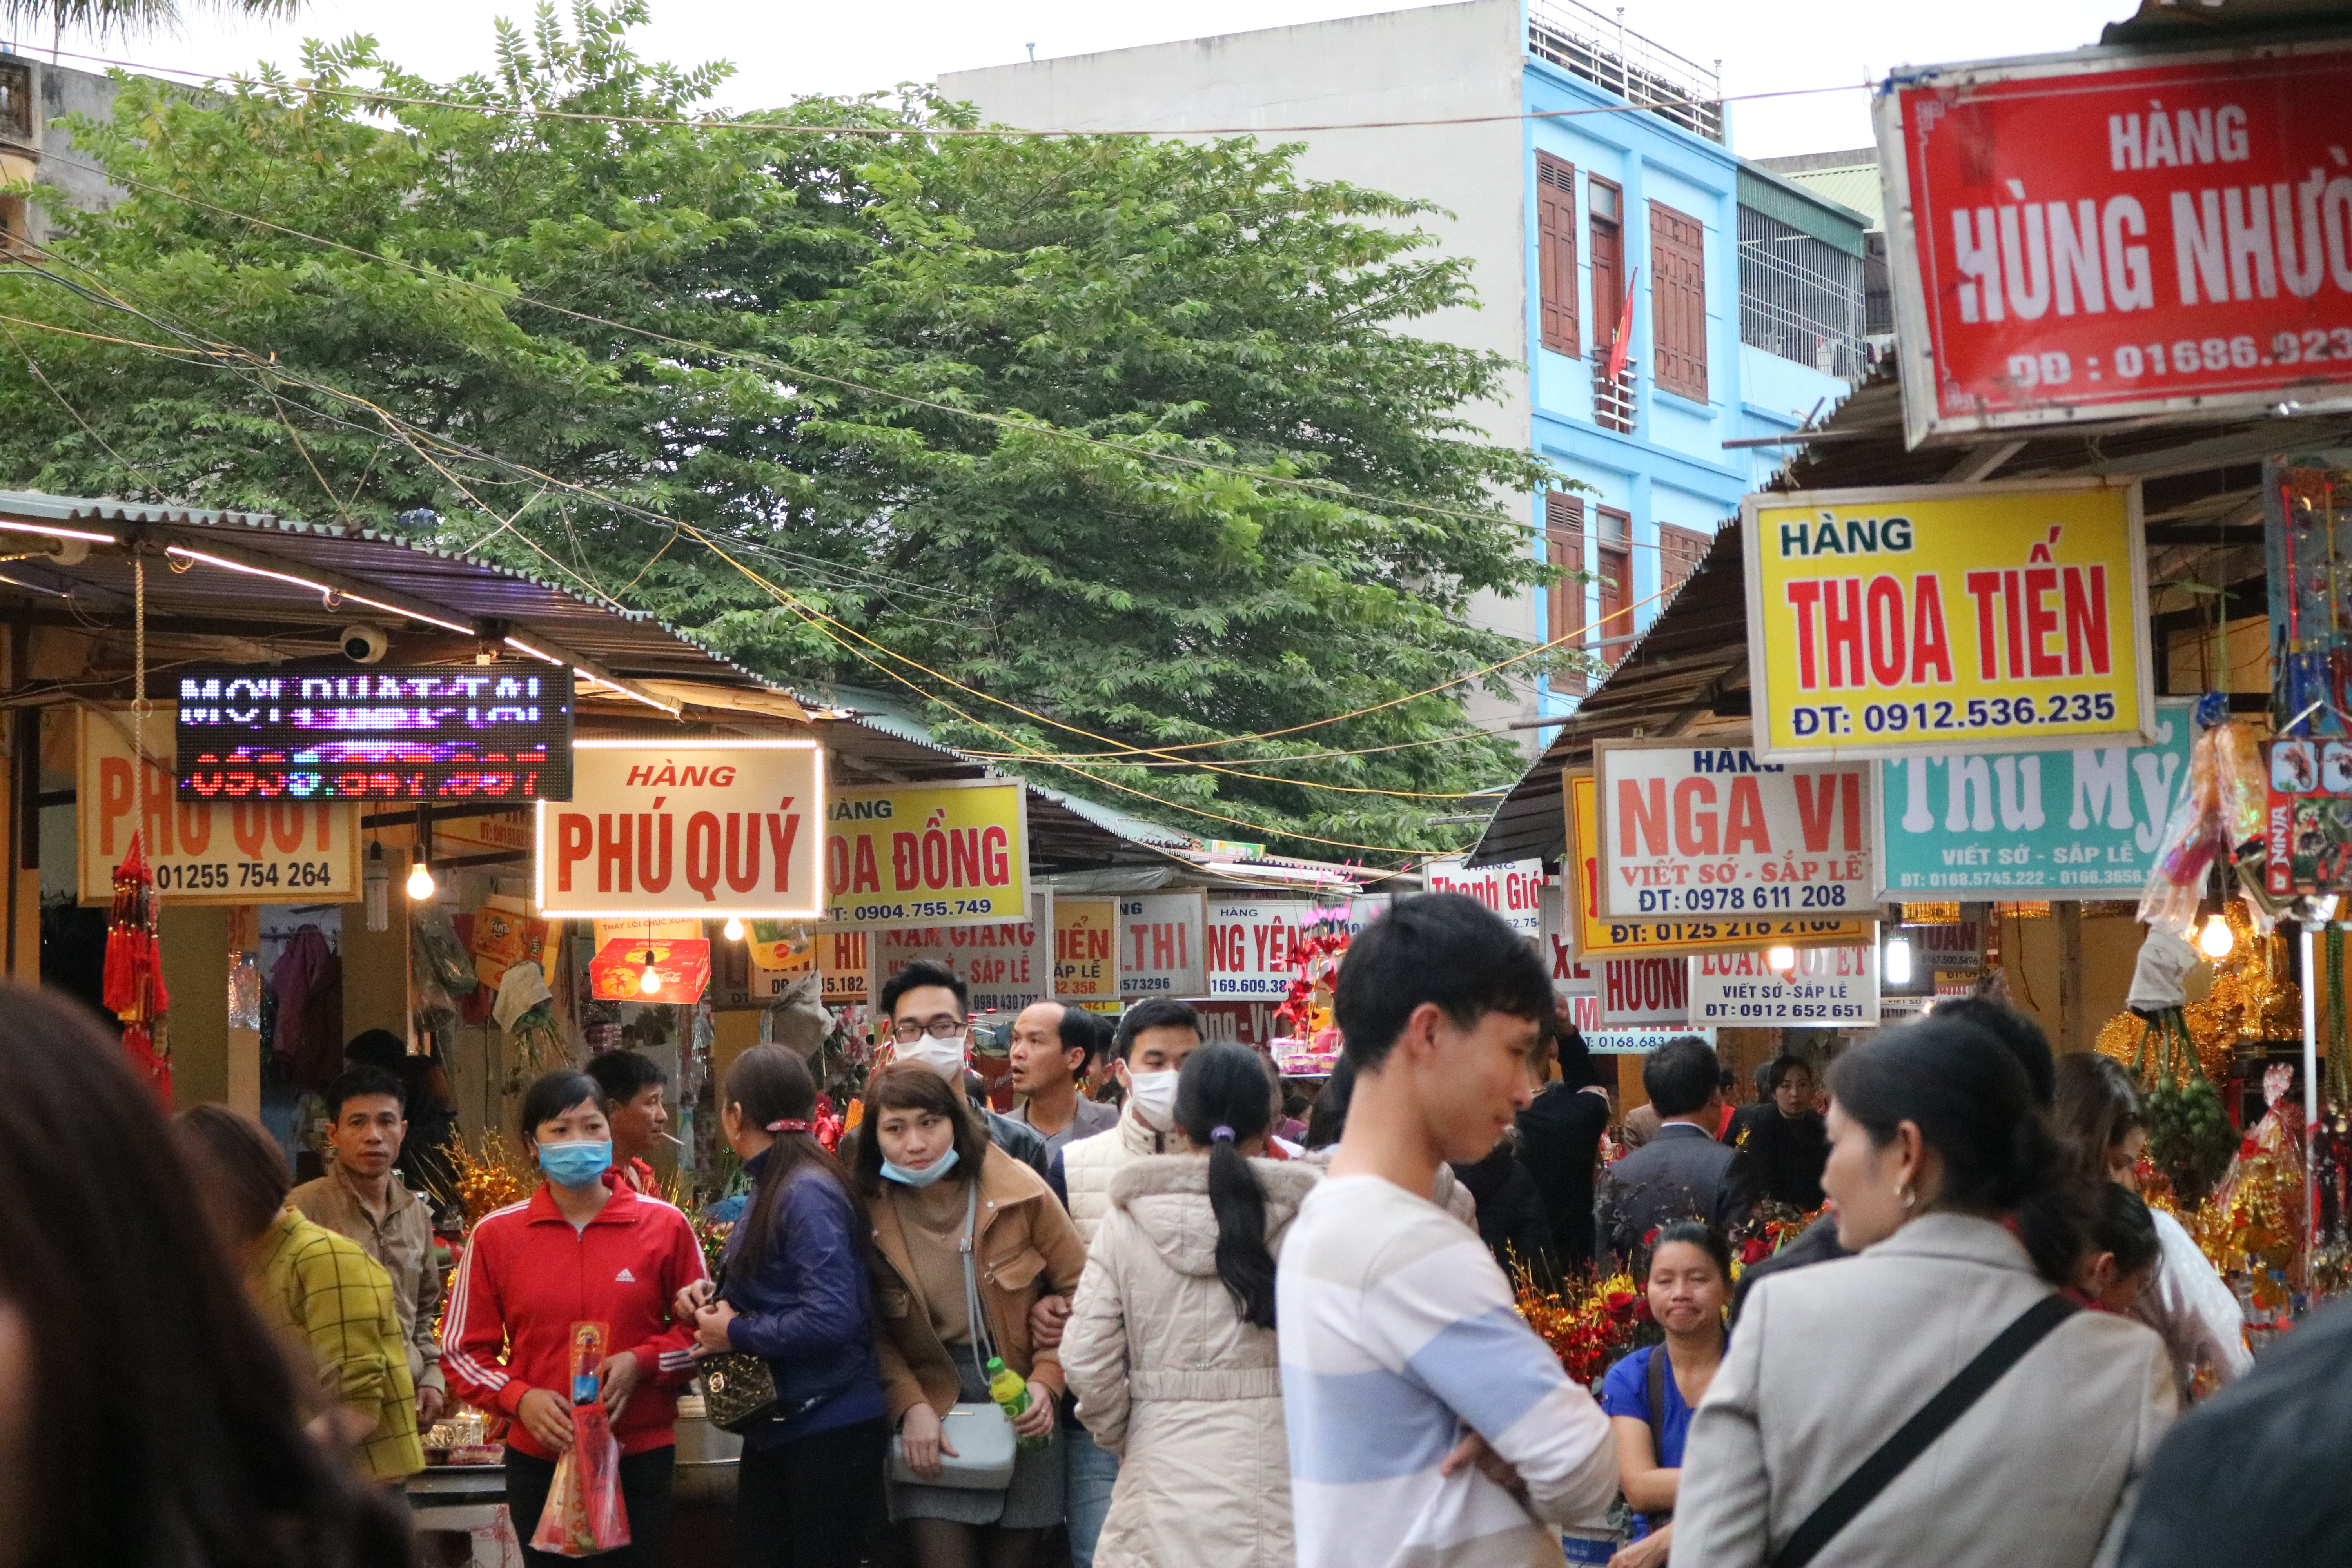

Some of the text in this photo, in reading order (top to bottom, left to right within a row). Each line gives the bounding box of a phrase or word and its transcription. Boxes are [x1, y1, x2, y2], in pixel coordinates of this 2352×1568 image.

[2108, 99, 2249, 171] HÀNG
[1952, 178, 2154, 323] HÙNG
[1780, 514, 1912, 556] HÀNG
[1787, 525, 2110, 689] THOA TIẾN
[1792, 693, 2115, 736] ĐT: 0912.536.235
[626, 759, 736, 786] HÀNG
[1617, 773, 1861, 858] NGA VI
[558, 796, 800, 901] PHÚ QUÝ
[893, 809, 1009, 891] ĐỒNG
[2272, 806, 2290, 868] NINJA
[1619, 858, 1690, 886] VIẾT
[1698, 857, 1739, 884] SỚ
[1761, 850, 1819, 883] SẮP
[1829, 852, 1867, 881] LỄ
[1942, 845, 1991, 865] VIẾT
[158, 862, 331, 889] 01255 754 264
[855, 899, 992, 920] 0904.755.749
[1220, 907, 1258, 917] HÀNG
[1639, 885, 1846, 912] ĐT: 0978 611 208
[1054, 915, 1109, 960] IỂN
[1120, 978, 1170, 990] 573296
[1212, 979, 1294, 993] 169.609.38
[1723, 983, 1757, 998] VIẾT
[1762, 982, 1783, 998] SỚ
[1830, 981, 1847, 998] LỄ
[1001, 994, 1018, 1010] 430
[1740, 1004, 1787, 1016] 0912
[1792, 1004, 1826, 1017] 652
[1832, 1004, 1862, 1017] 651
